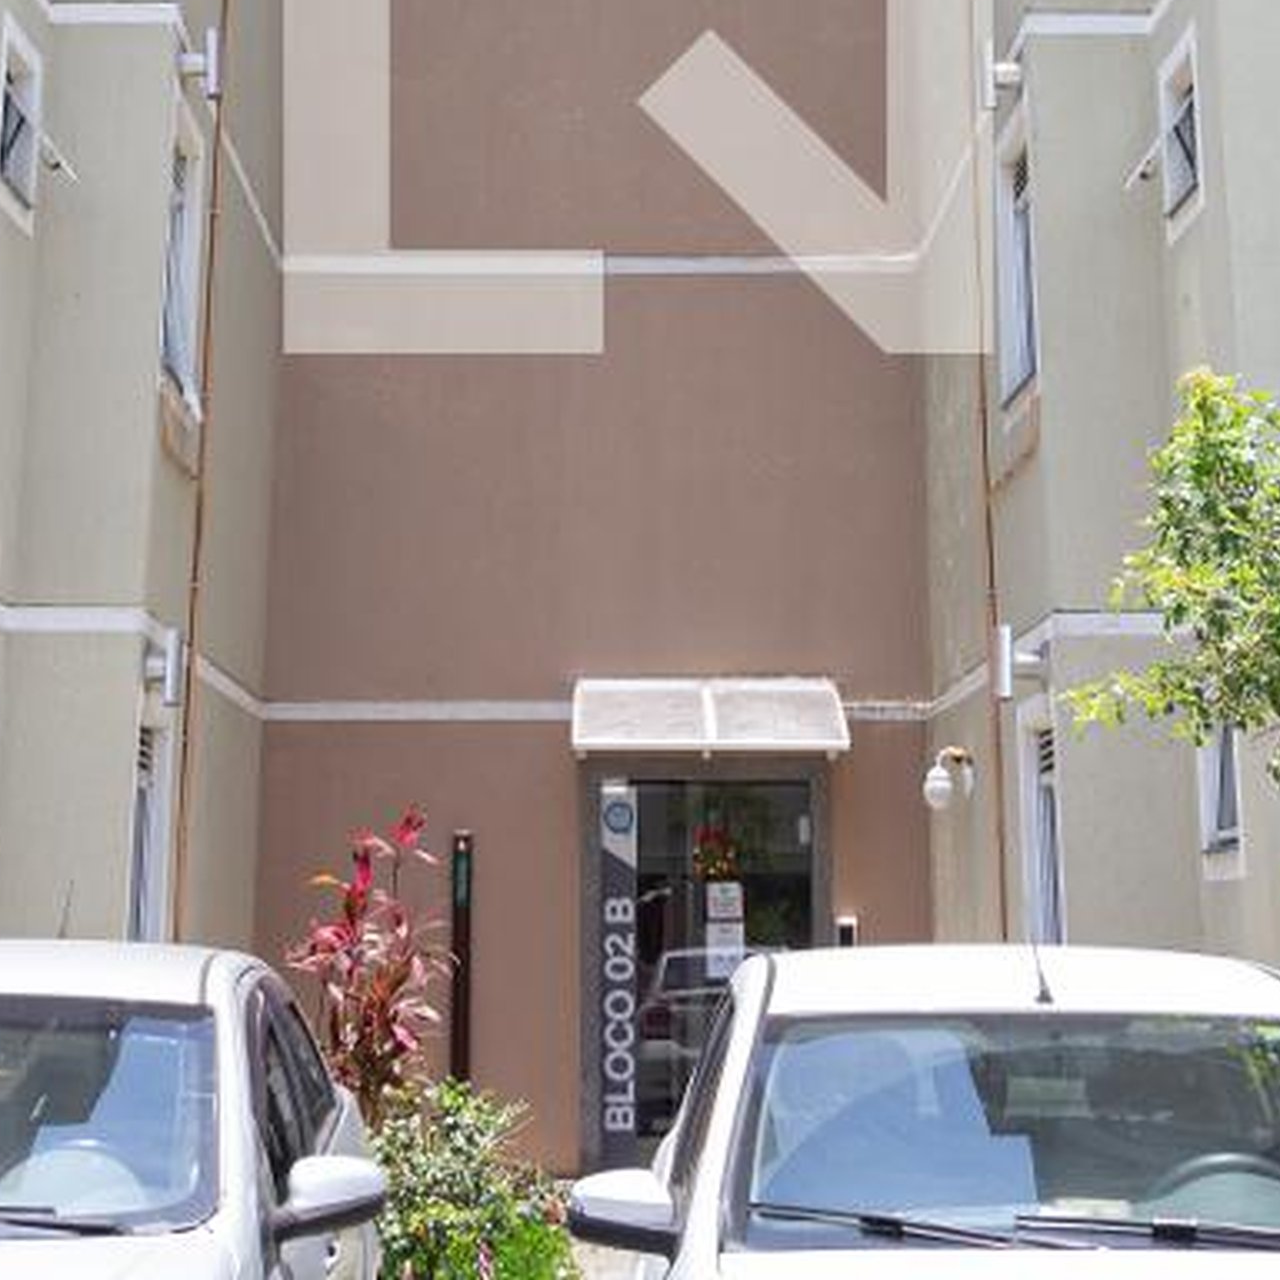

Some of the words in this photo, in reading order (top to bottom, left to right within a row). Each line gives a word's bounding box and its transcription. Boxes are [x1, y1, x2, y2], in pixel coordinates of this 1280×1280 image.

[604, 897, 635, 922] B
[604, 933, 635, 981] 02
[604, 989, 635, 1130] BLOCO
